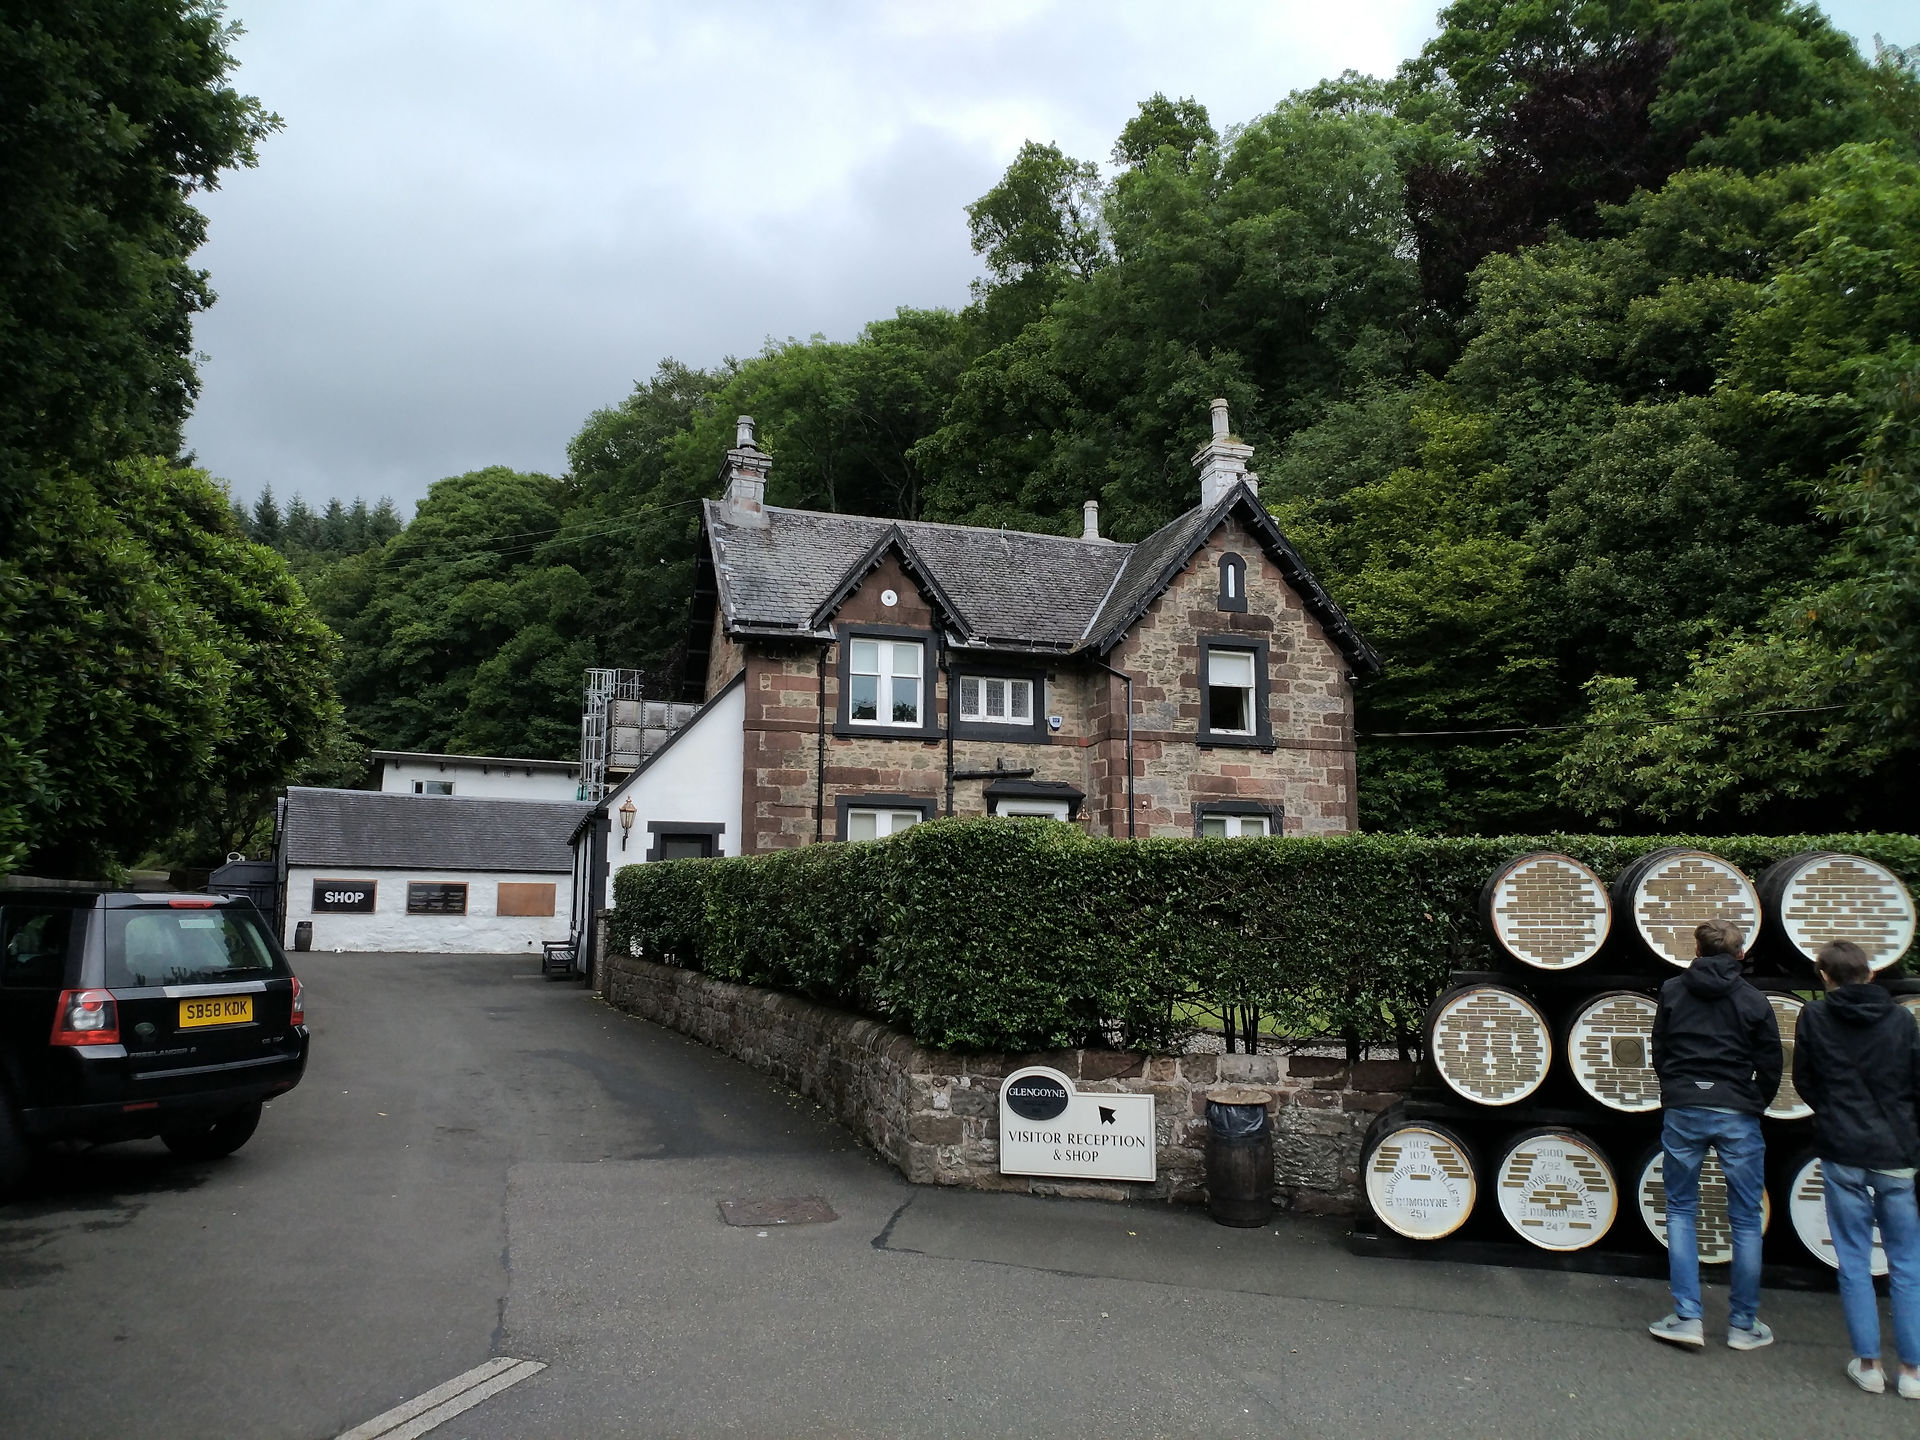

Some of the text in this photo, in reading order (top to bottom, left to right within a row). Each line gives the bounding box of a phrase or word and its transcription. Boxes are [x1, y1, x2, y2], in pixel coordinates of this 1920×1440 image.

[324, 891, 365, 903] SHOP
[187, 1000, 247, 1019] SB58 KDK
[129, 1047, 188, 1057] FREELANDER
[1008, 1087, 1066, 1098] GLENGOYNE
[1008, 1130, 1146, 1148] VISITOR RECEPTION
[1053, 1149, 1099, 1162] & SHOP
[1536, 1148, 1564, 1158] 2000
[1540, 1160, 1561, 1171] 792
[1420, 1163, 1461, 1208] DISTILLE
[1556, 1174, 1598, 1220] DISTILLERY
[1409, 1208, 1427, 1219] 251
[1545, 1221, 1566, 1232] 247
